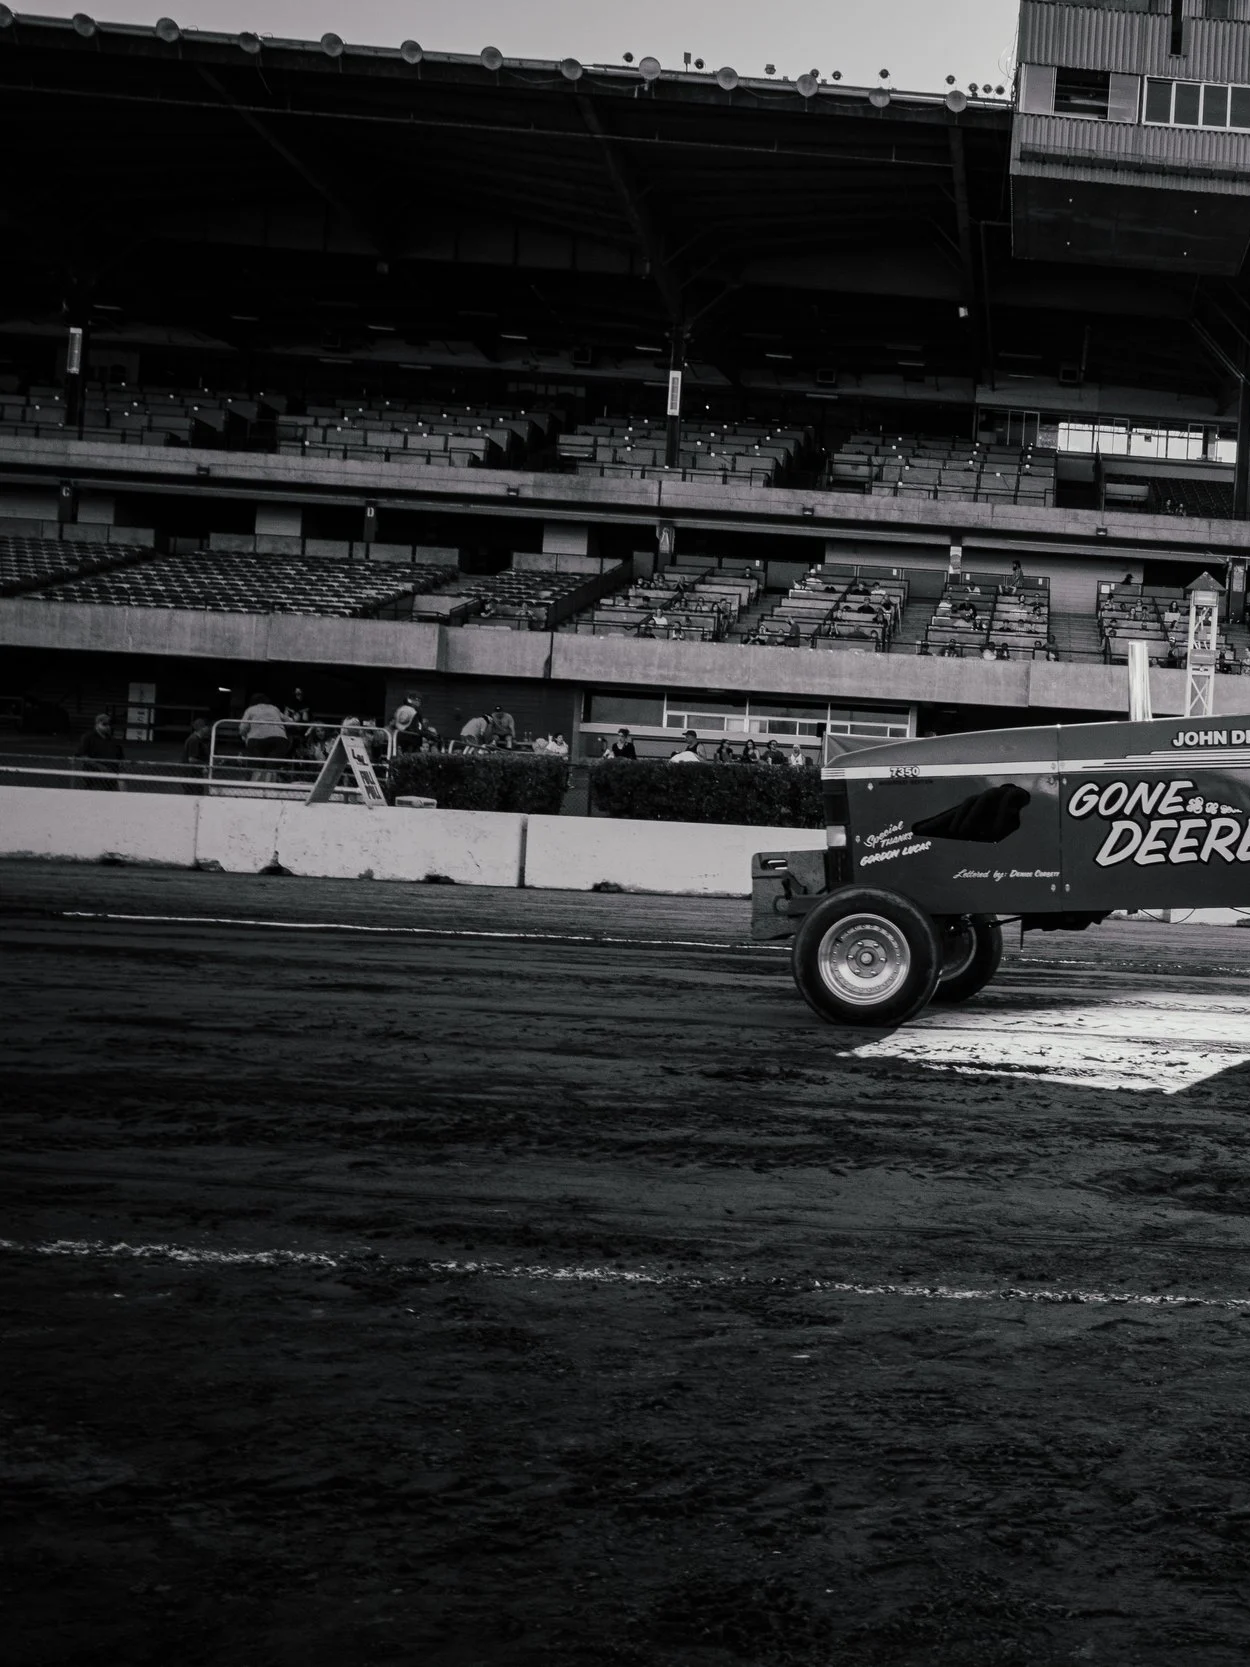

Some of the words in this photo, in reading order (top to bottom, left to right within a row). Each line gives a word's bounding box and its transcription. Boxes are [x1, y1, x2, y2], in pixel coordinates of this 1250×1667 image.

[1172, 730, 1228, 747] JOHN
[890, 766, 920, 778] 7350
[1067, 780, 1194, 817] GONE
[863, 820, 904, 849] Special
[880, 831, 914, 848] THANKS
[859, 848, 900, 867] GORDON
[901, 840, 932, 856] LUCAS
[952, 868, 991, 879] Lettered
